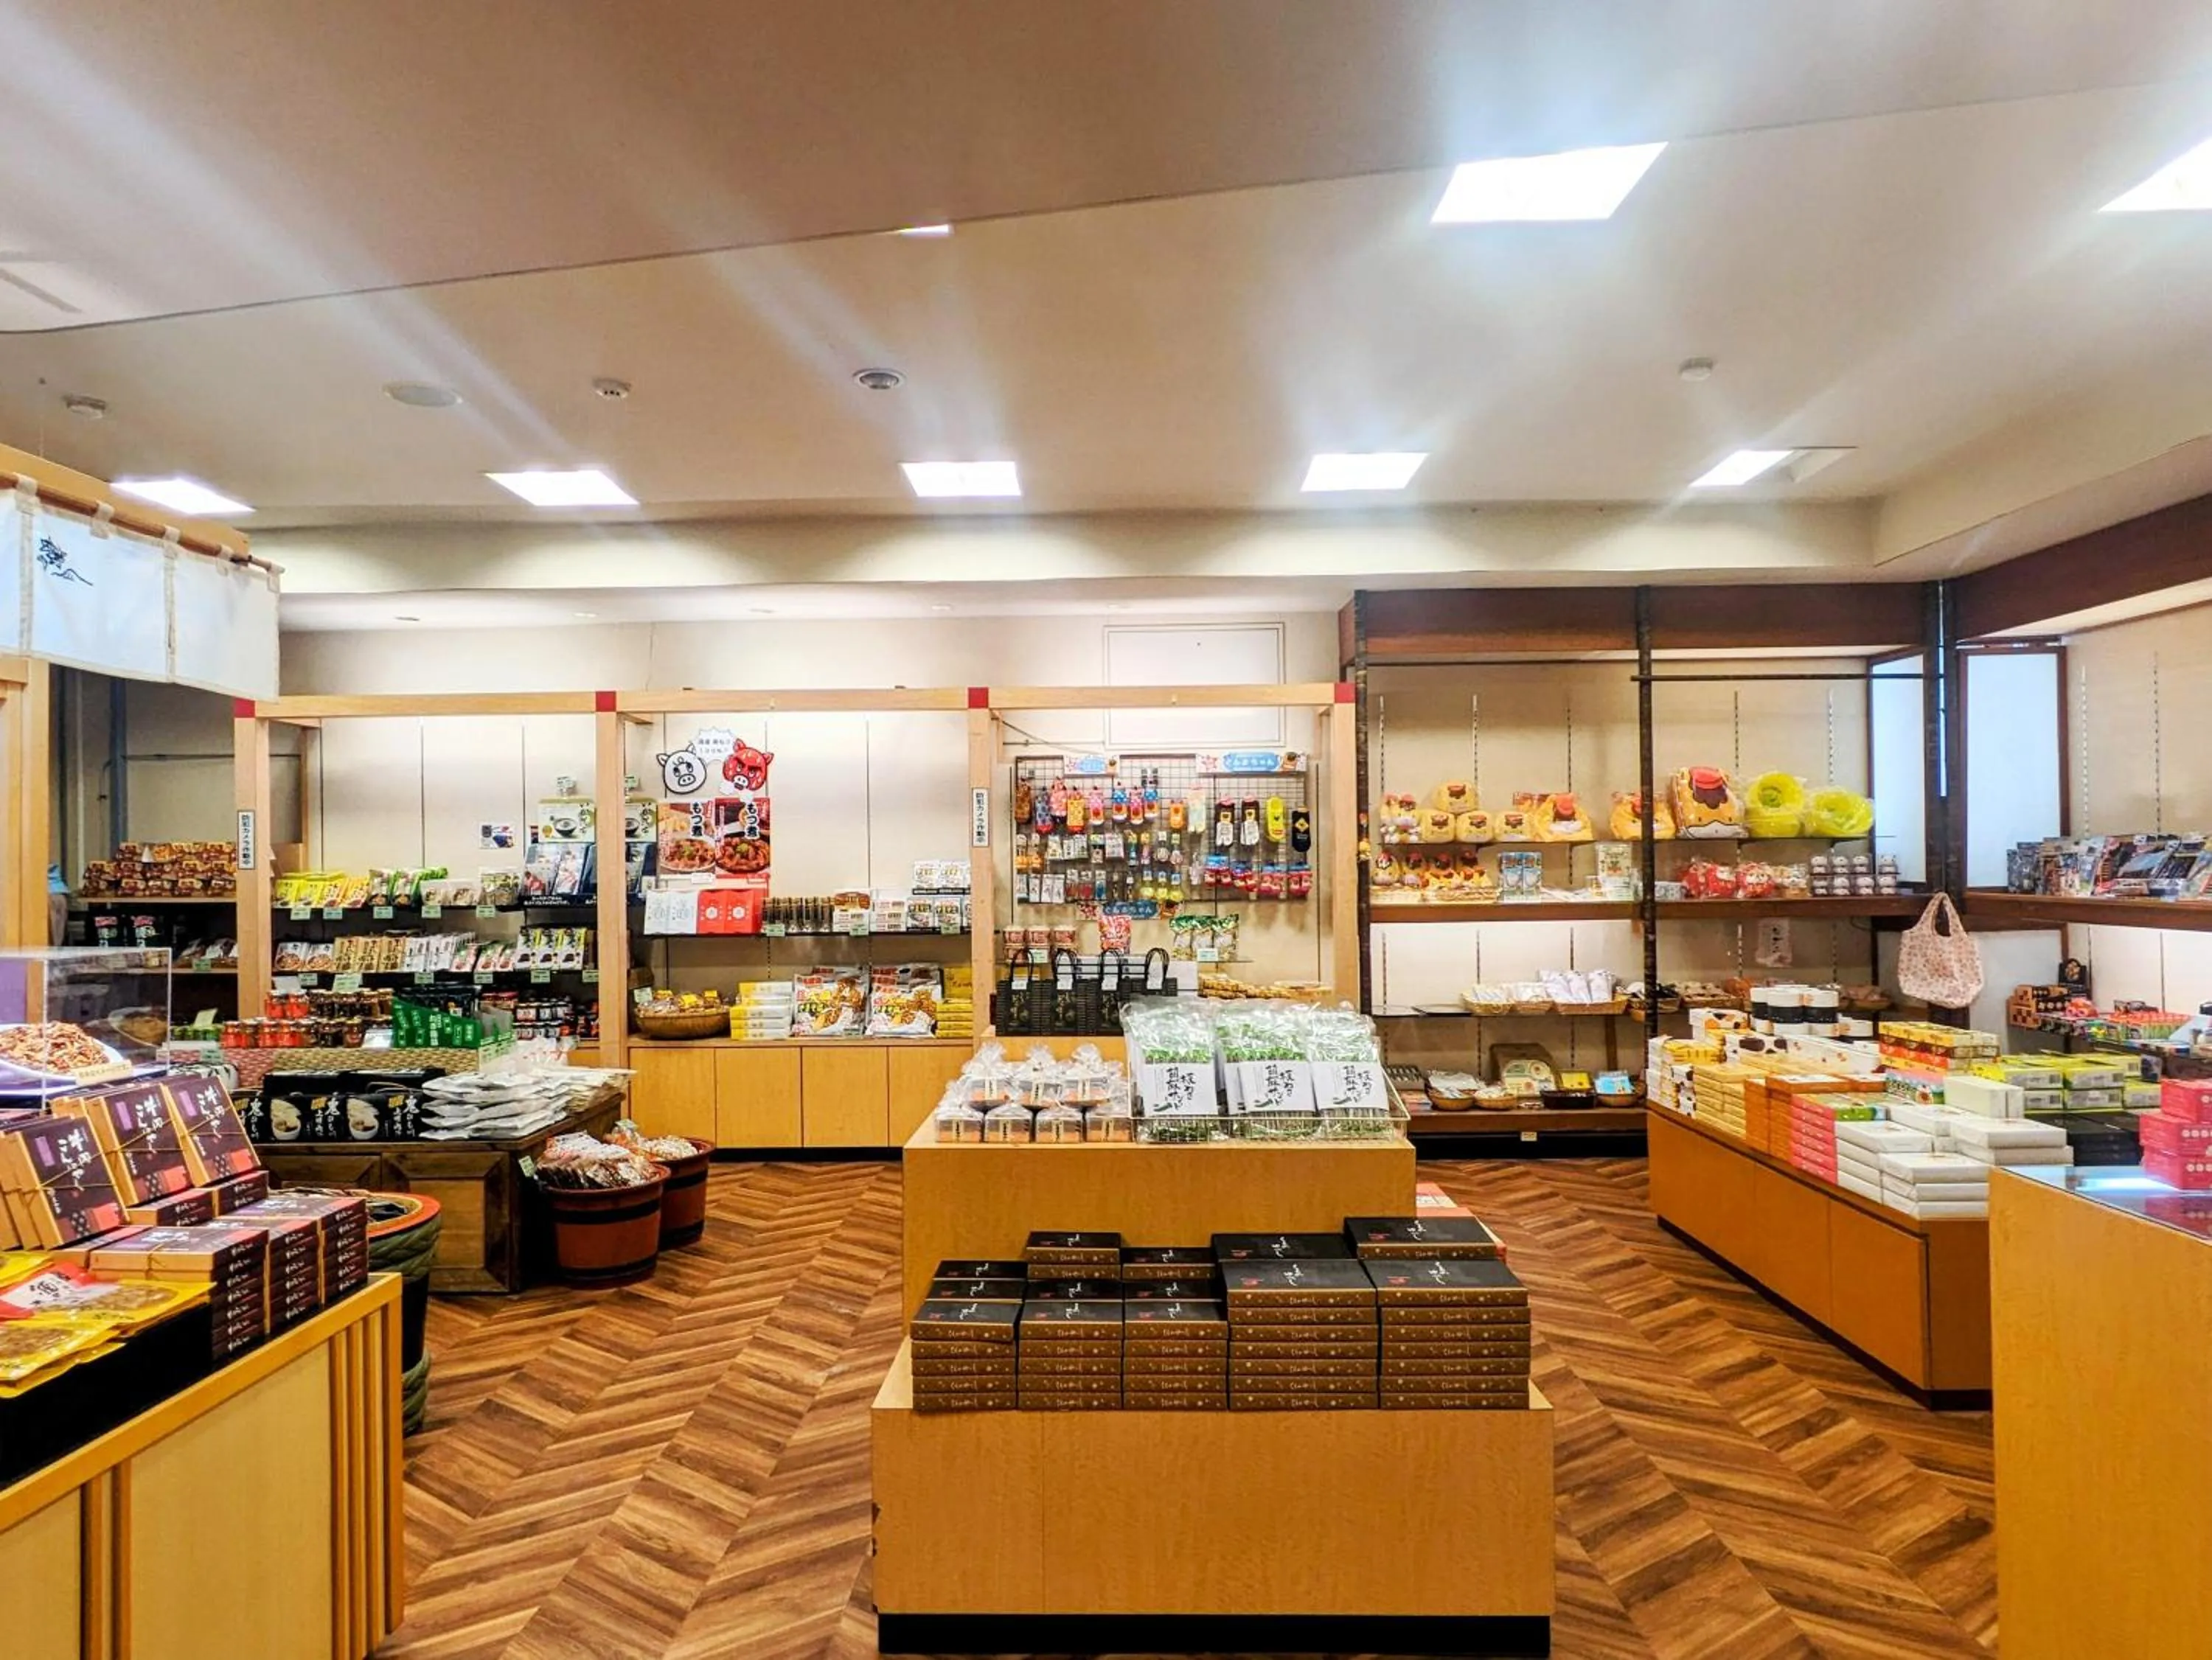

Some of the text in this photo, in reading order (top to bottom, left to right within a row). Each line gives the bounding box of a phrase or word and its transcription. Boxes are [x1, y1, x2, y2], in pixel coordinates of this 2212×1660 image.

[691, 802, 703, 837] もつ煮
[746, 803, 758, 837] もつ煮
